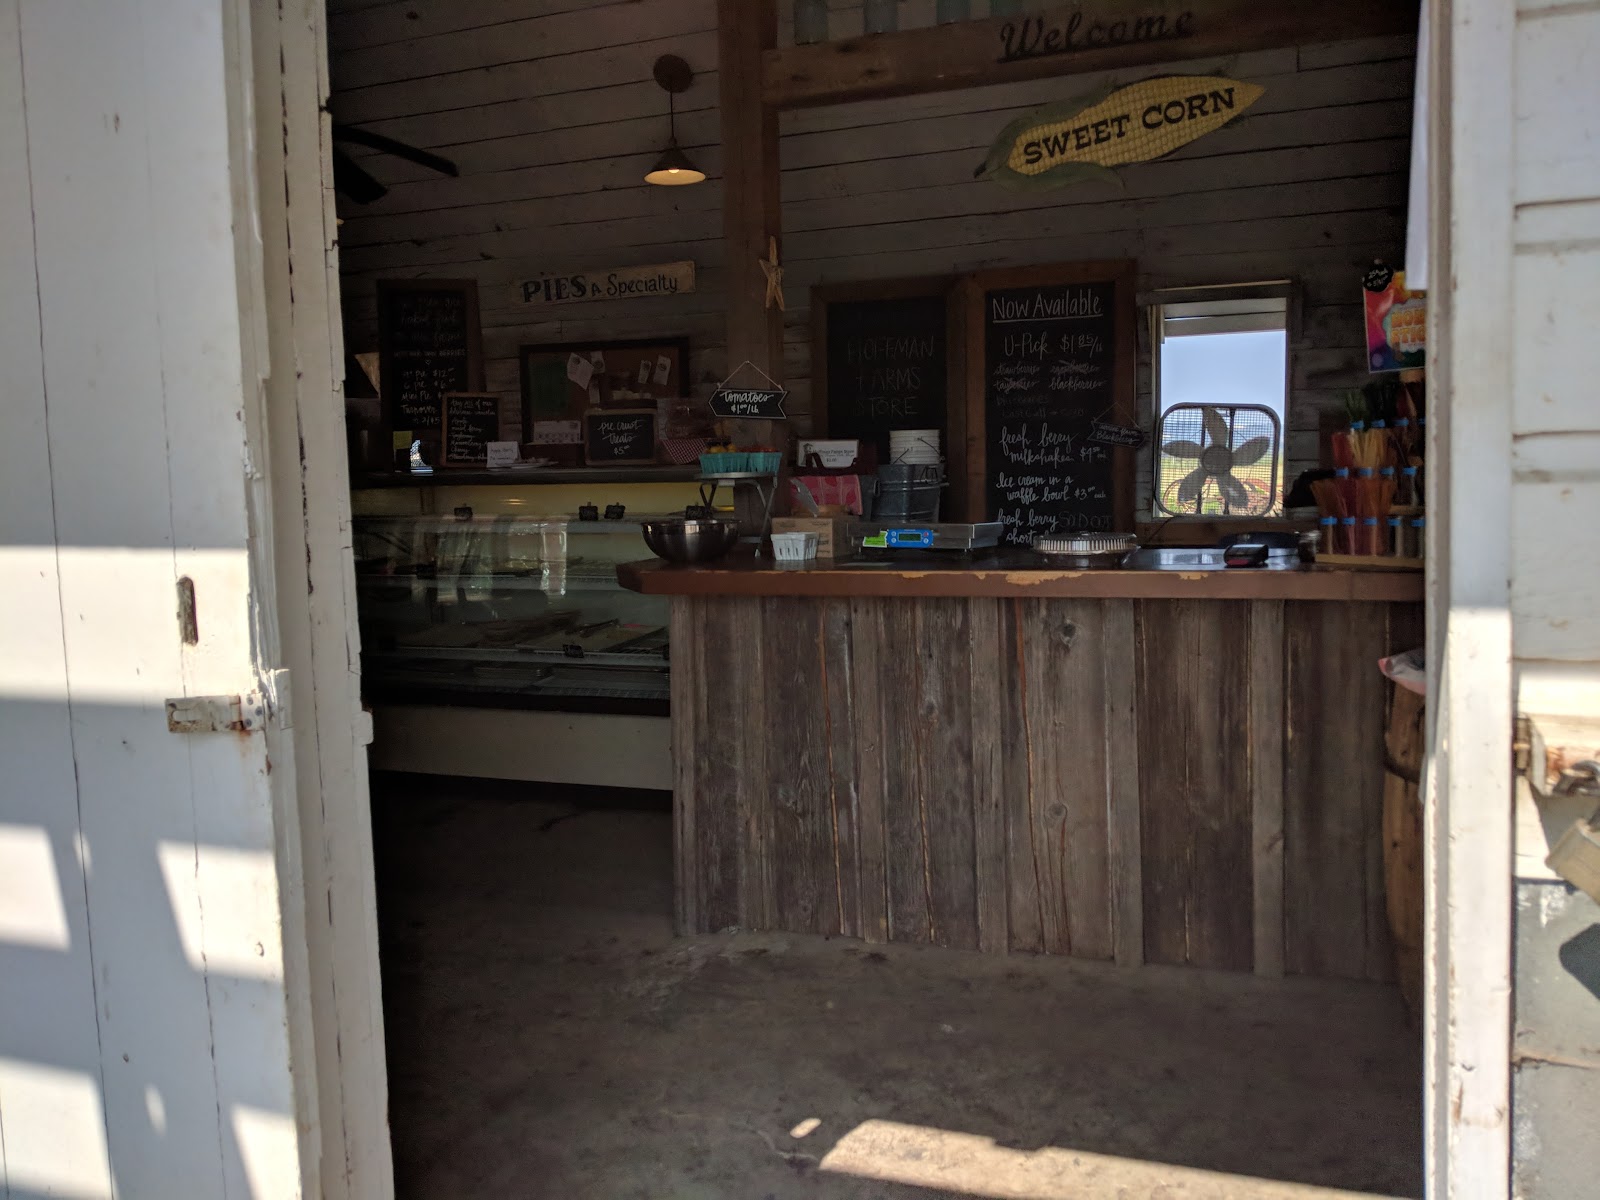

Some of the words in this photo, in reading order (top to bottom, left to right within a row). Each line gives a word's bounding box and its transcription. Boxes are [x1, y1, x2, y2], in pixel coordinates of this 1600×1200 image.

[999, 11, 1195, 59] Welcome
[1022, 114, 1130, 165] SWEET
[1142, 87, 1237, 131] CORN
[520, 274, 587, 304] PIES
[606, 273, 679, 296] Specialty
[992, 296, 1029, 320] Now
[1032, 289, 1103, 318] Available
[998, 422, 1032, 457] fresh
[1037, 422, 1079, 454] berry
[1009, 447, 1075, 469] milkshakes
[1006, 487, 1040, 505] waffle
[1040, 485, 1071, 502] bowl
[1017, 476, 1047, 487] cream
[1048, 476, 1061, 486] in
[1064, 476, 1075, 485] a
[1027, 508, 1059, 532] berry
